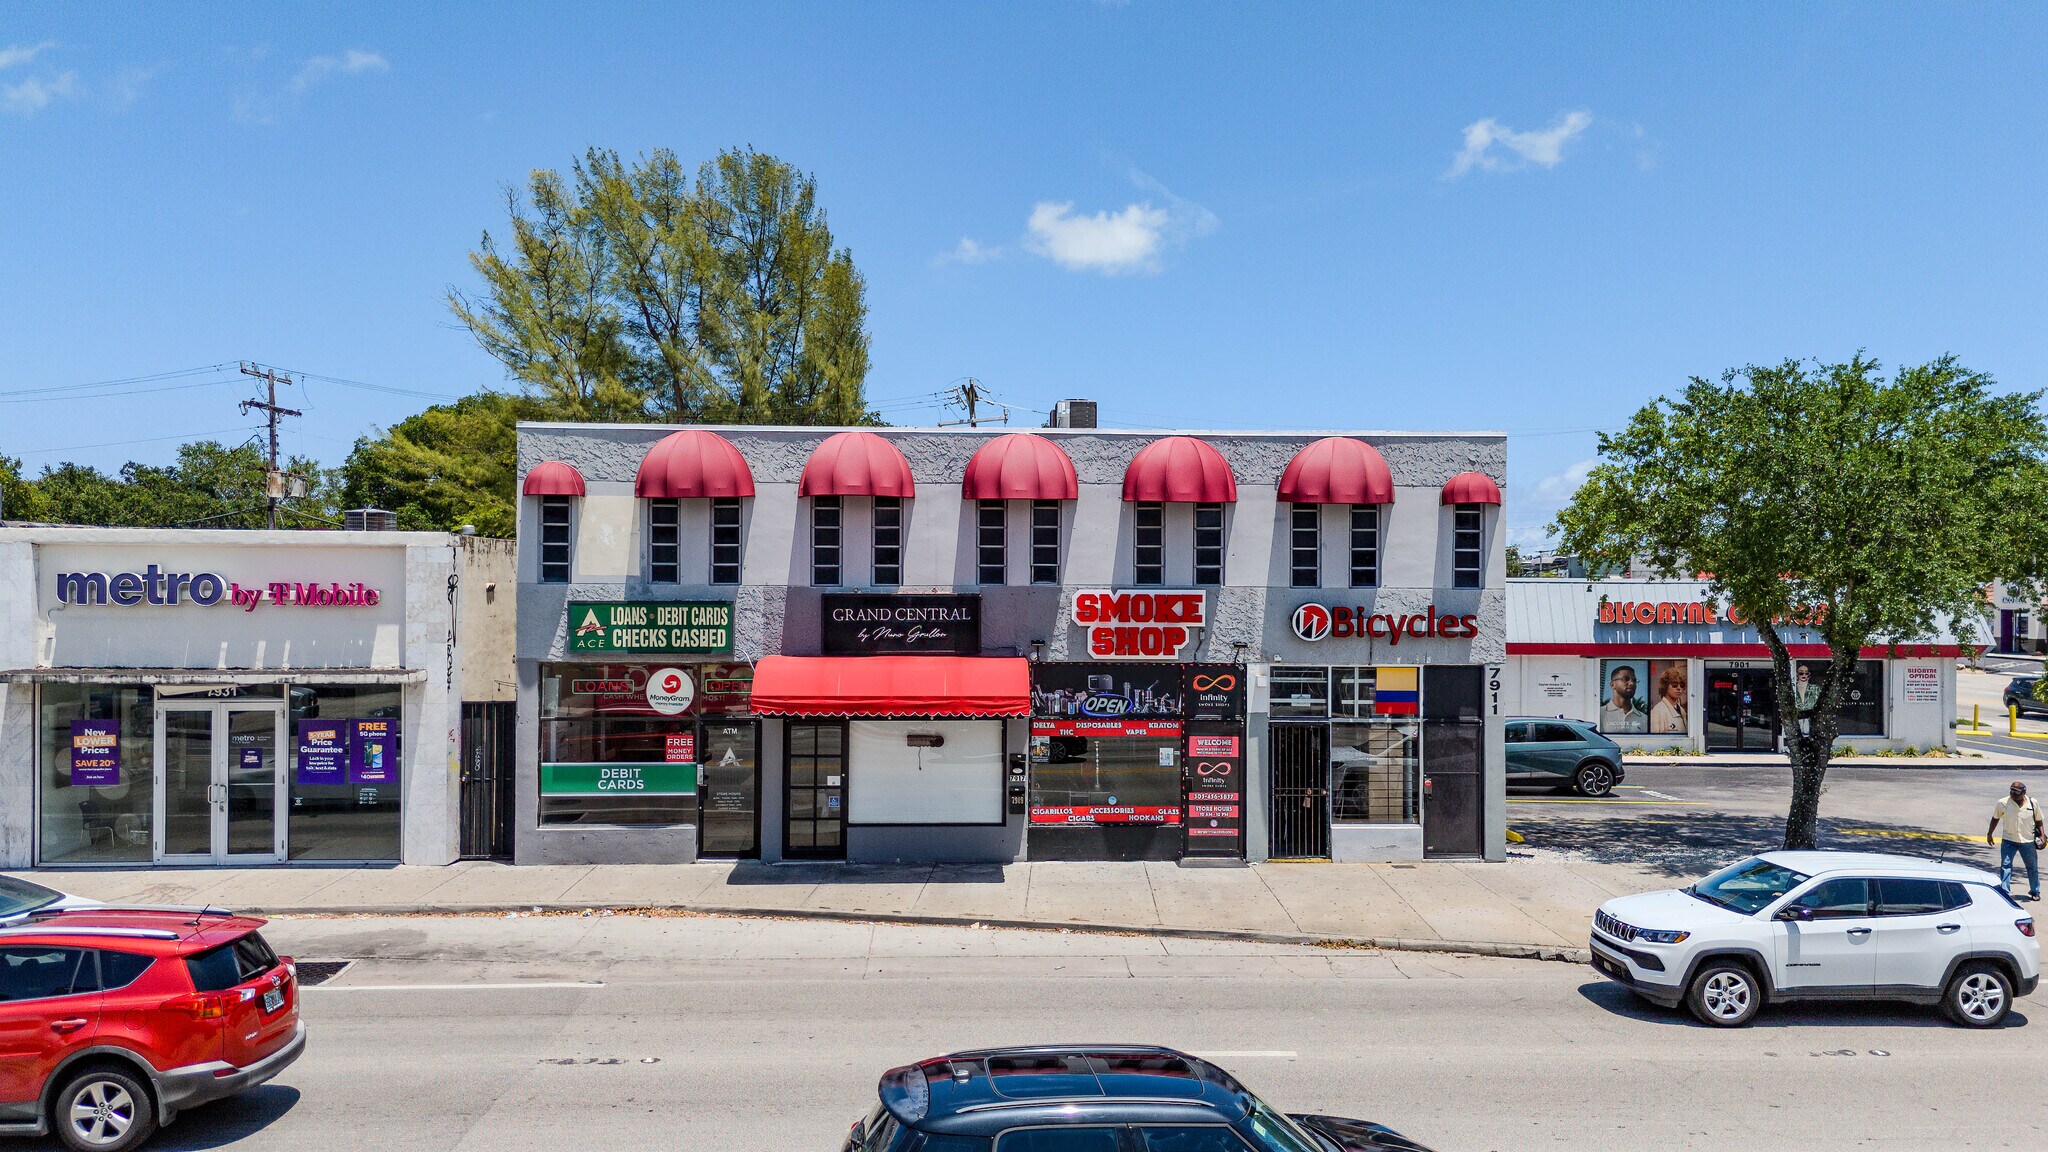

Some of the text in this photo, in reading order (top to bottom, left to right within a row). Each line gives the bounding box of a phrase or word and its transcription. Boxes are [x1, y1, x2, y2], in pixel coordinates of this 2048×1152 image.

[57, 564, 227, 607] metro
[231, 582, 261, 613] by
[832, 607, 971, 621] GRAND CENTRAL
[1076, 593, 1203, 624] SMOKE
[1599, 601, 1717, 624] BISCAYNE
[610, 606, 729, 626] LOANS DEBIT CARDS
[1331, 605, 1478, 646] Bicycles
[612, 628, 727, 648] CHECKS CASHED
[857, 628, 870, 642] by
[577, 639, 606, 648] ACE
[1092, 626, 1187, 656] SHOP
[576, 681, 631, 692] LOANS
[1489, 667, 1501, 716] 7911
[649, 694, 690, 702] MoneyGram
[1200, 694, 1228, 702] Infinity
[1085, 696, 1130, 714] OPEN
[84, 728, 106, 736] New
[358, 722, 388, 731] FREE
[76, 736, 114, 746] LOWER
[232, 734, 255, 742] metro
[311, 738, 333, 746] Price
[667, 738, 694, 747] FREE
[81, 746, 109, 754] Prices
[75, 759, 98, 767] SAVE
[601, 768, 642, 779] DEBIT
[597, 779, 645, 790] CARDS
